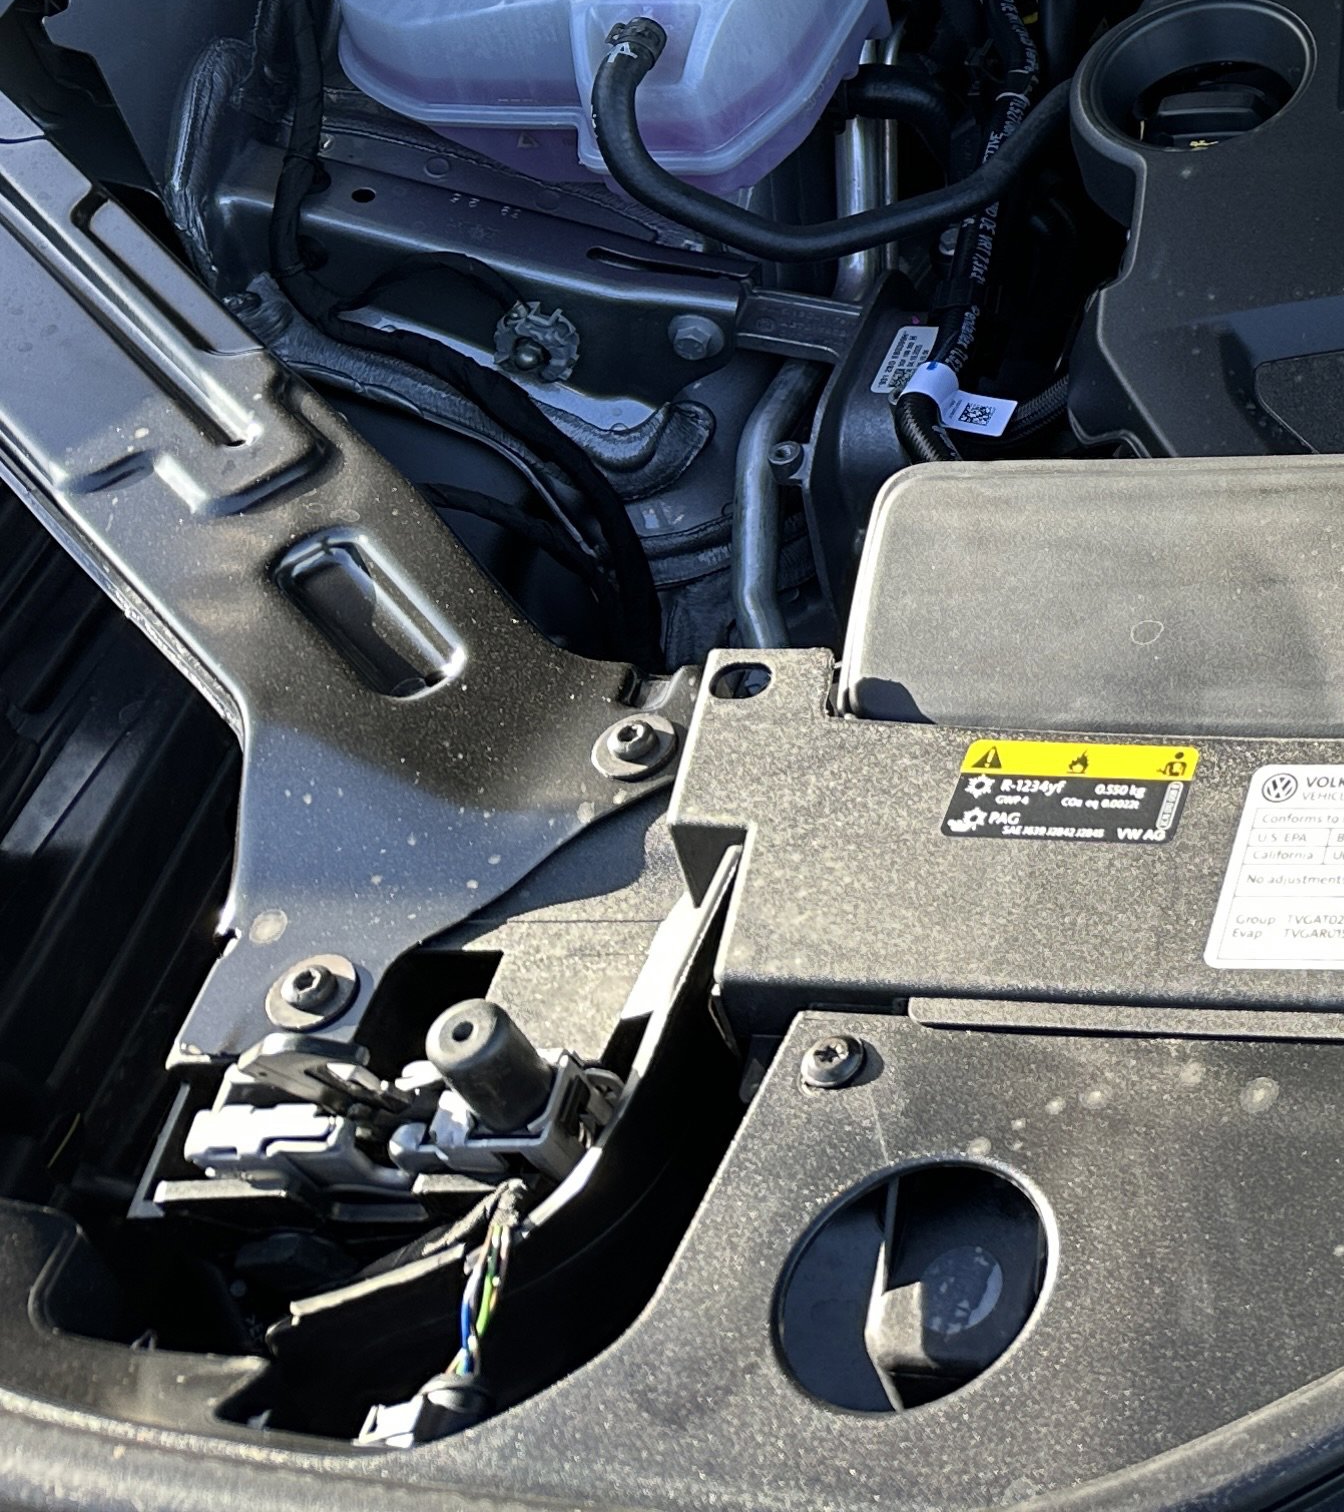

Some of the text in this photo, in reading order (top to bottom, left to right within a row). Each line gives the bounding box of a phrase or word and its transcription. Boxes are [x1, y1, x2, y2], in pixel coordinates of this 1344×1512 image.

[1000, 778, 1067, 797] R-1234yf
[1128, 784, 1147, 799] kg
[988, 811, 1021, 825] PAG
[1262, 813, 1322, 824] Conforms
[1326, 815, 1340, 824] to
[1116, 828, 1143, 840] VW
[1142, 829, 1167, 842] AG
[1283, 833, 1307, 842] EPA
[1252, 849, 1314, 859] California
[1247, 874, 1264, 884] No
[1235, 914, 1277, 926] Group
[1231, 928, 1263, 940] Evap
